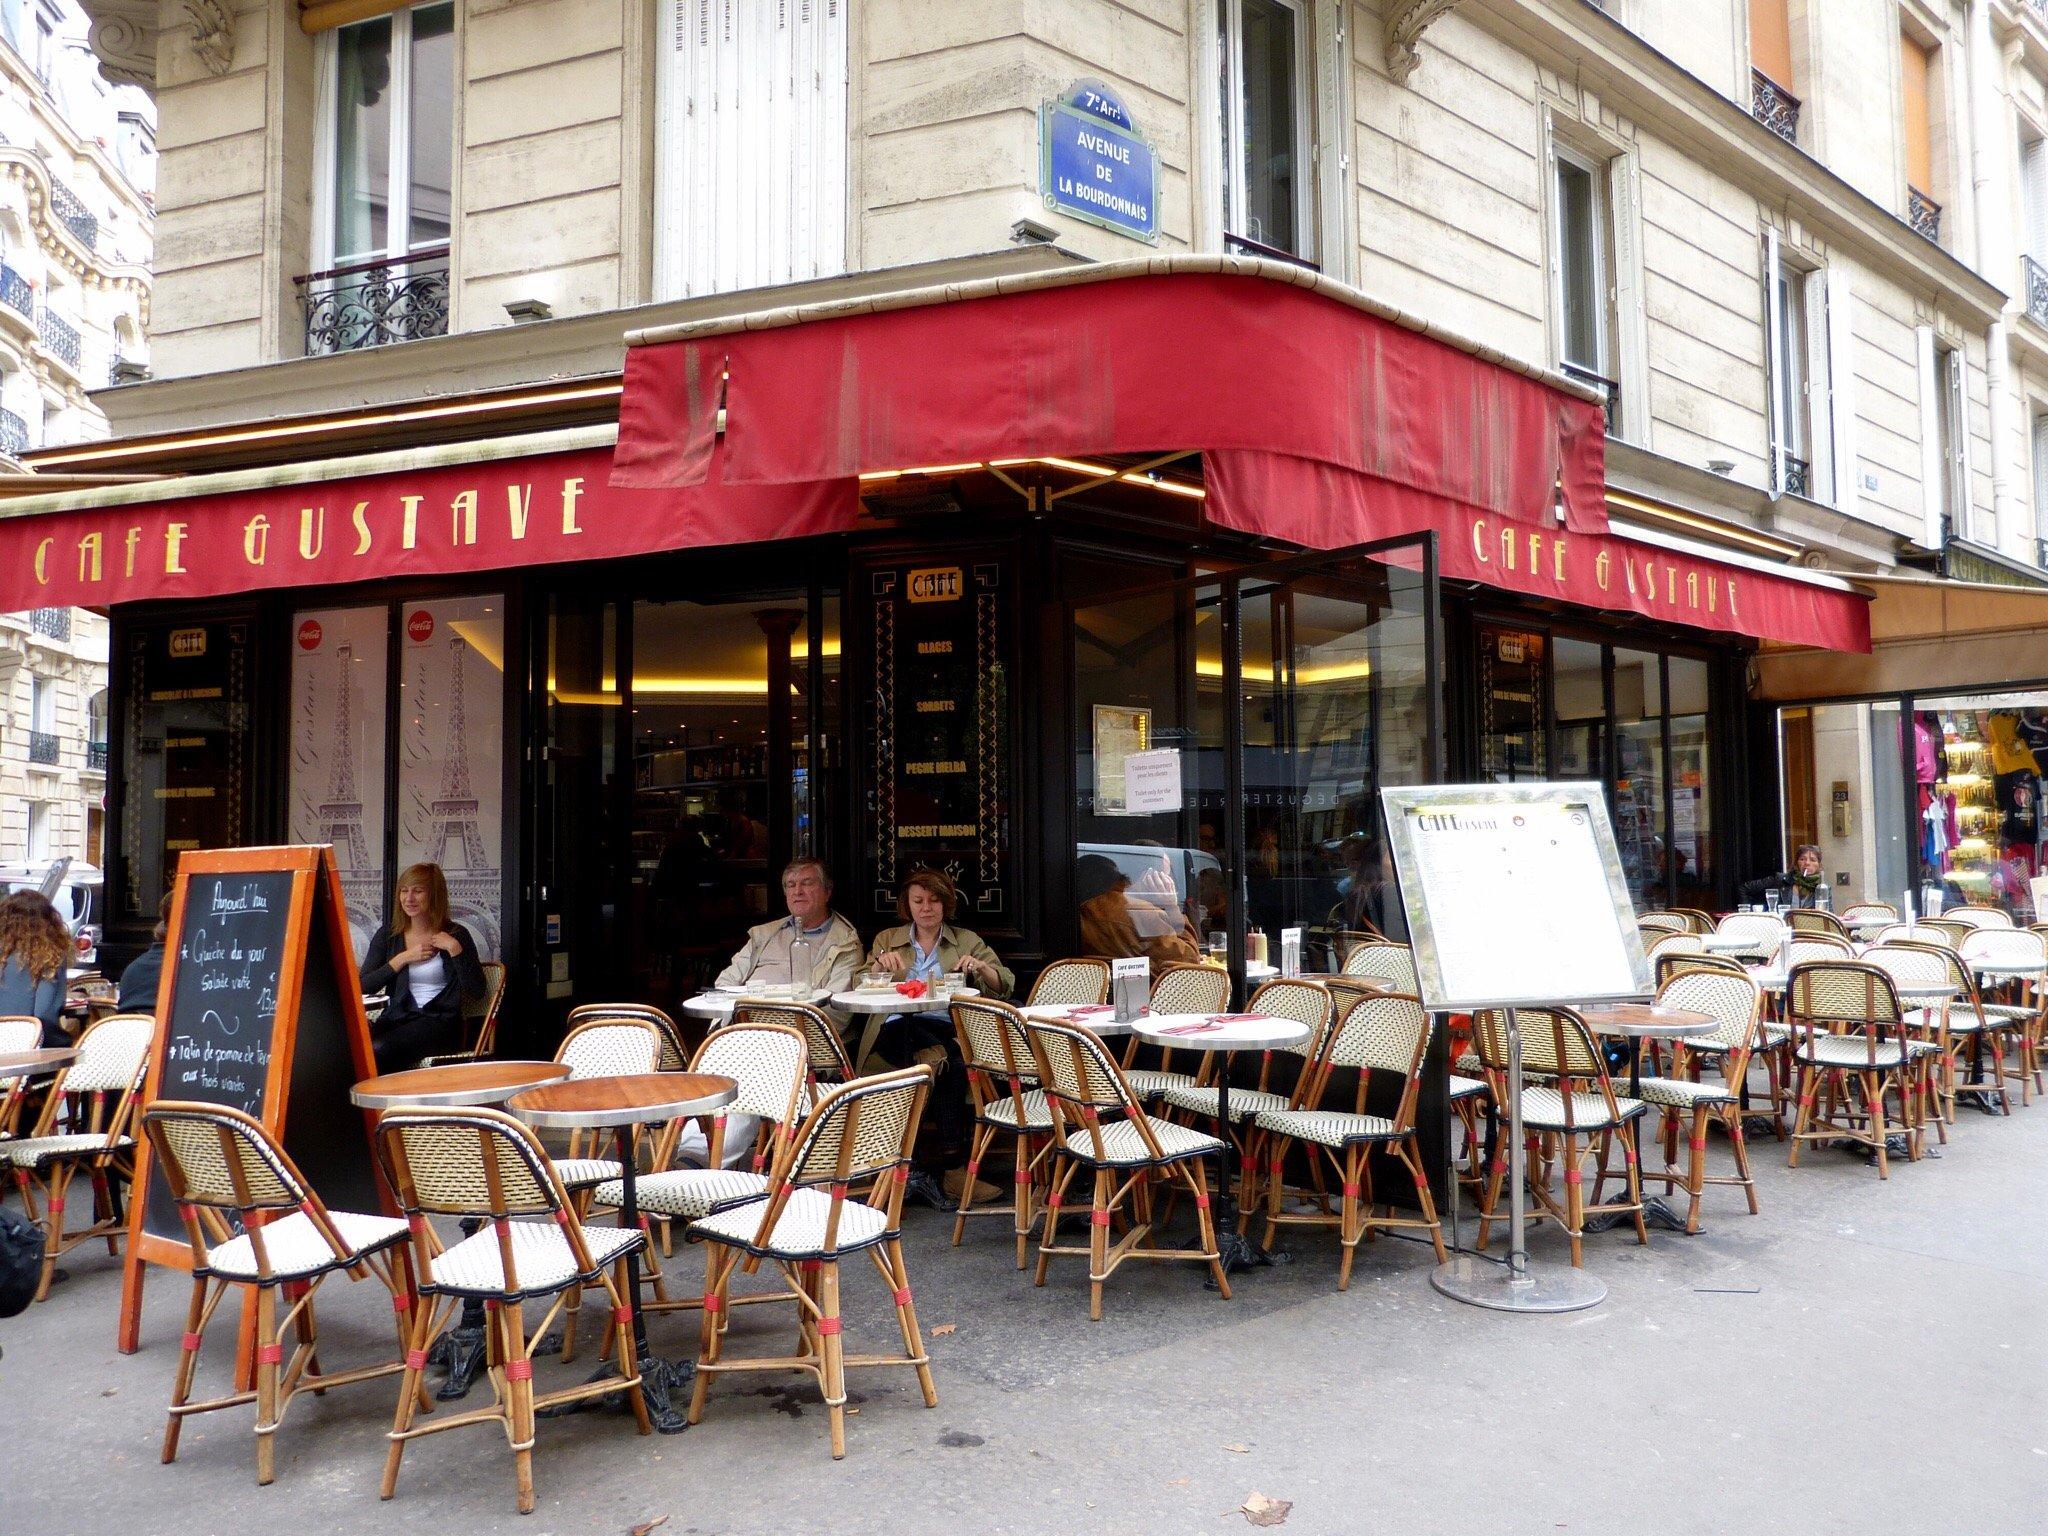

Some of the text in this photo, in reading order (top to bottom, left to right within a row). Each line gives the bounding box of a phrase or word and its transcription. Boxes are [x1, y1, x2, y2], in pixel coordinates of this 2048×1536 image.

[1077, 131, 1130, 165] AVENUE
[1096, 164, 1113, 183] DE
[1059, 177, 1147, 222] LA BOURDONNAIS
[35, 476, 585, 585] CAFE GUSTAVE
[1473, 520, 1738, 616] CAFE GUSTAVE
[913, 572, 958, 598] CAFE
[1835, 792, 1847, 801] 23
[898, 825, 938, 838] DESSERT
[231, 939, 243, 960] du
[244, 947, 267, 976] jour
[201, 969, 229, 991] Salade
[204, 1041, 214, 1062] de
[215, 1049, 243, 1073] pomme
[244, 1045, 255, 1065] de
